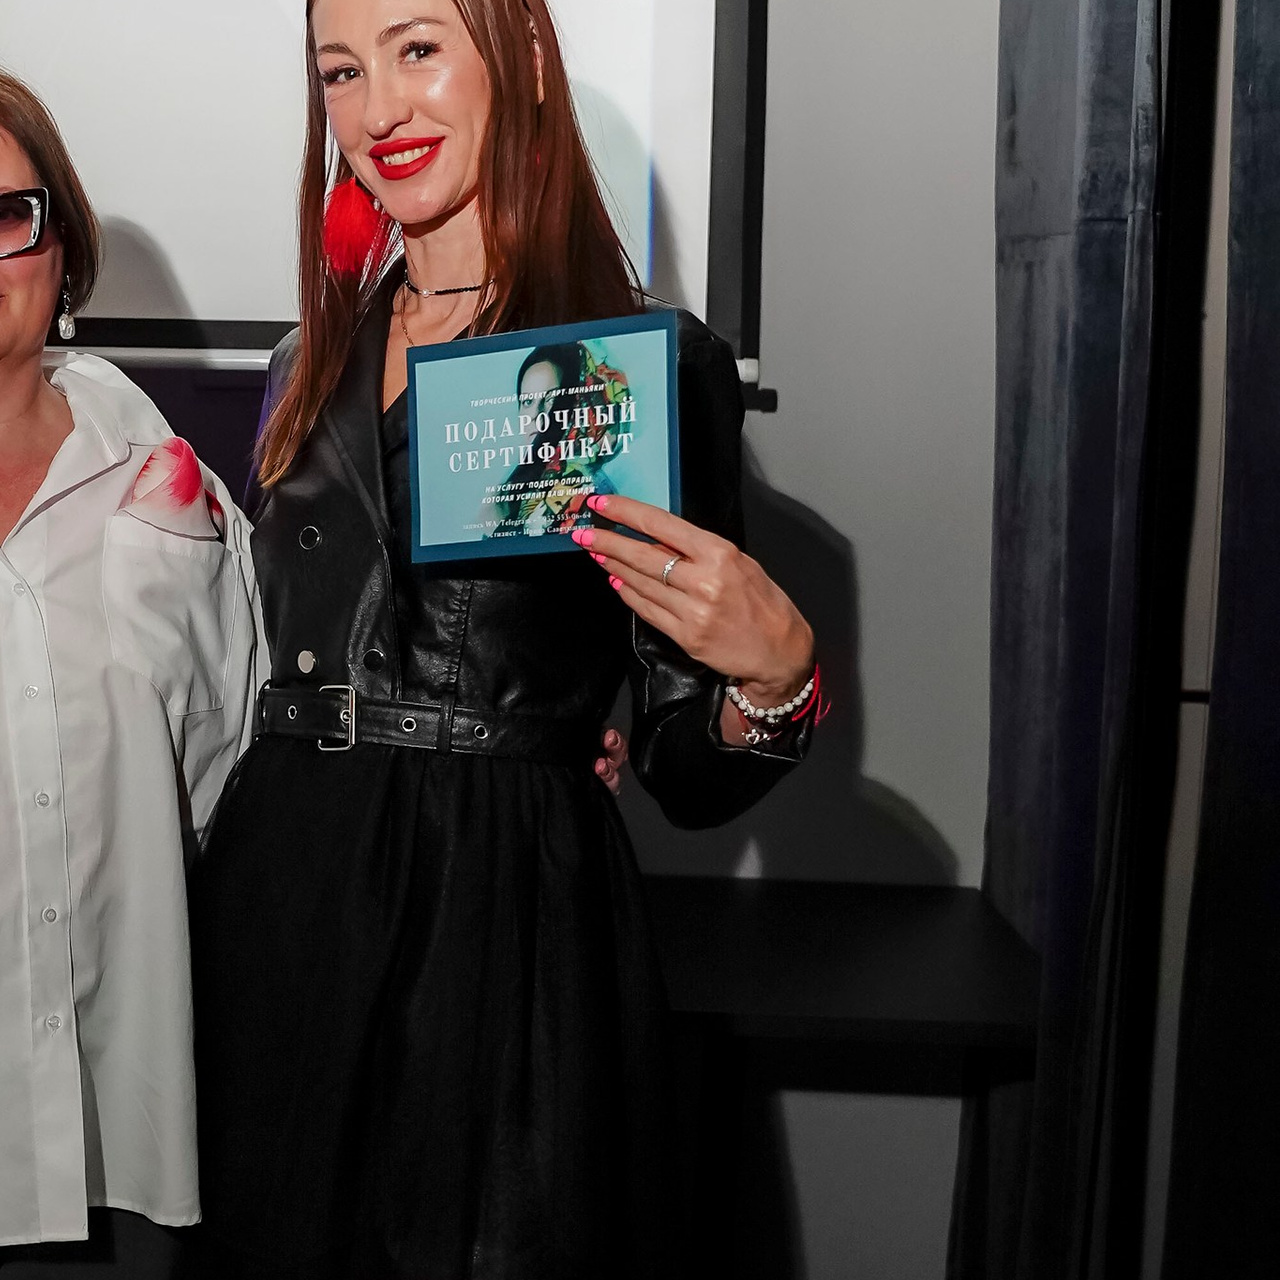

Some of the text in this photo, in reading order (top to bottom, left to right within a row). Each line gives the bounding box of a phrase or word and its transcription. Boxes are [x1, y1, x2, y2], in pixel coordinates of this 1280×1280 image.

[444, 396, 637, 444] ПОДАРОЧНЫЙ
[448, 432, 634, 473] СЕРТИФИКАТ
[481, 494, 515, 505] КОТОРАЯ
[516, 490, 547, 501] УСИЛИТ
[485, 485, 496, 494] НА
[496, 481, 525, 493] УСЛУГУ
